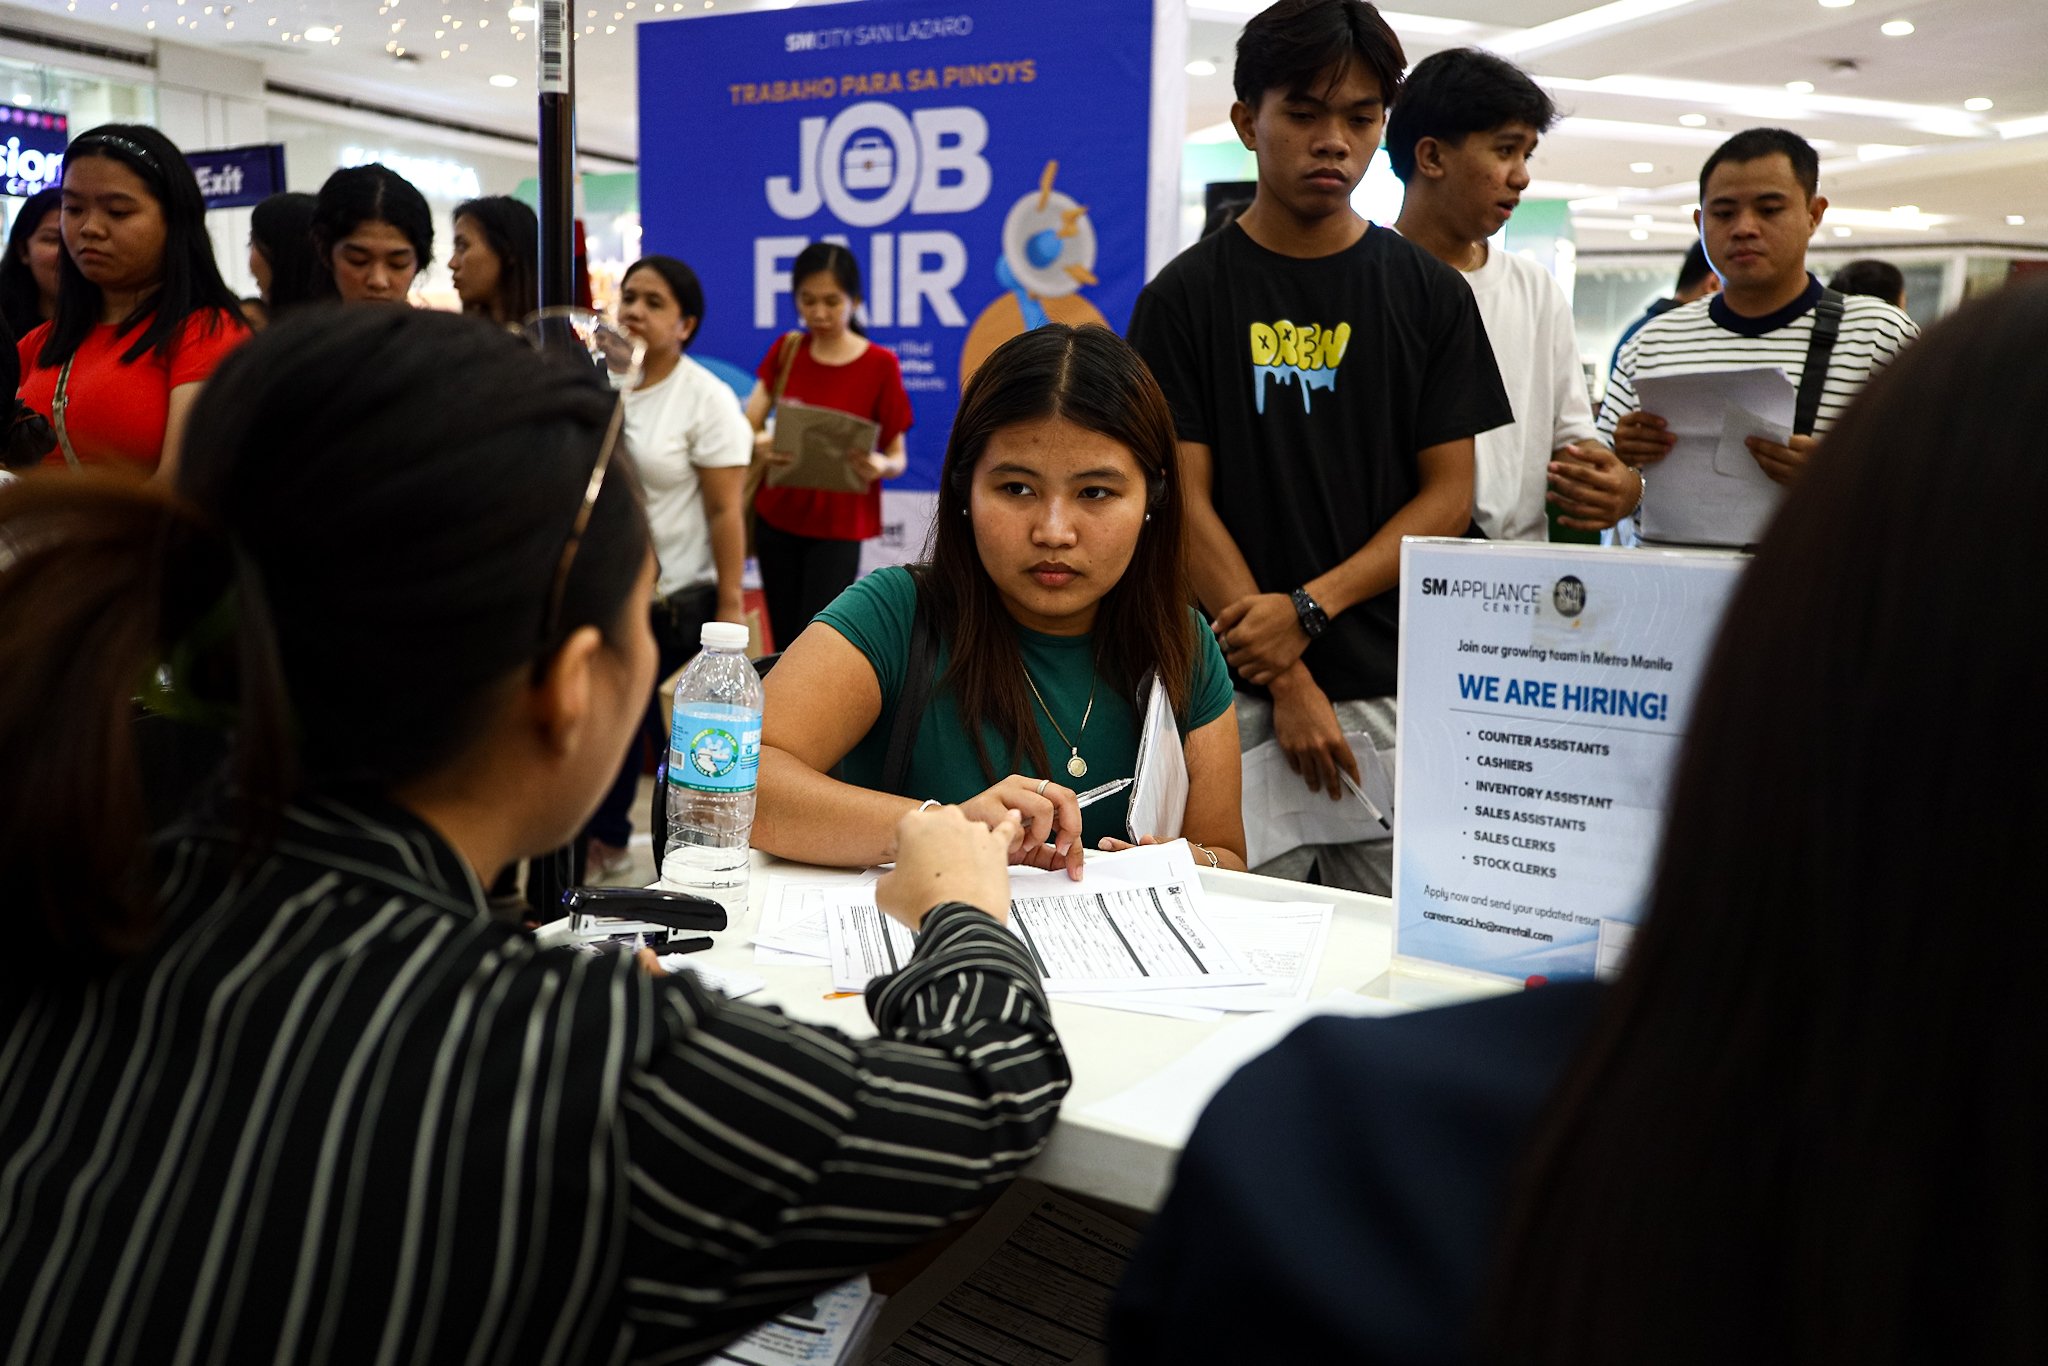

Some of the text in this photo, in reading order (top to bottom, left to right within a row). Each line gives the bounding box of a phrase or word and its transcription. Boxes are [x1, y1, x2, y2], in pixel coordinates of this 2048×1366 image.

[729, 59, 1036, 105] TRABAHO PARA SA PINOYS
[765, 101, 993, 228] JOB
[195, 164, 244, 197] Exit
[754, 230, 968, 329] FIR
[1250, 319, 1351, 371] DREW
[1422, 577, 1541, 603] SM APPLIANCE
[1458, 640, 1673, 671] Join our growing team in Metro Manila
[1458, 673, 1668, 722] WE ARE HIRING!
[1478, 730, 1610, 756] COUNTER ASSISTANTS
[1477, 755, 1533, 773] CASHIERS
[1476, 780, 1613, 810] INVENTORY ASSISTANT
[1475, 805, 1586, 832] SALES ASSISTANTS
[1474, 830, 1556, 853] SALES CLERKS
[1473, 855, 1557, 879] STOCK CLERKS
[1423, 884, 1450, 901] Apply
[1450, 892, 1470, 904] now
[1471, 896, 1489, 908] and
[1489, 898, 1511, 911] send
[1512, 904, 1534, 915] your
[1535, 907, 1573, 922] updated
